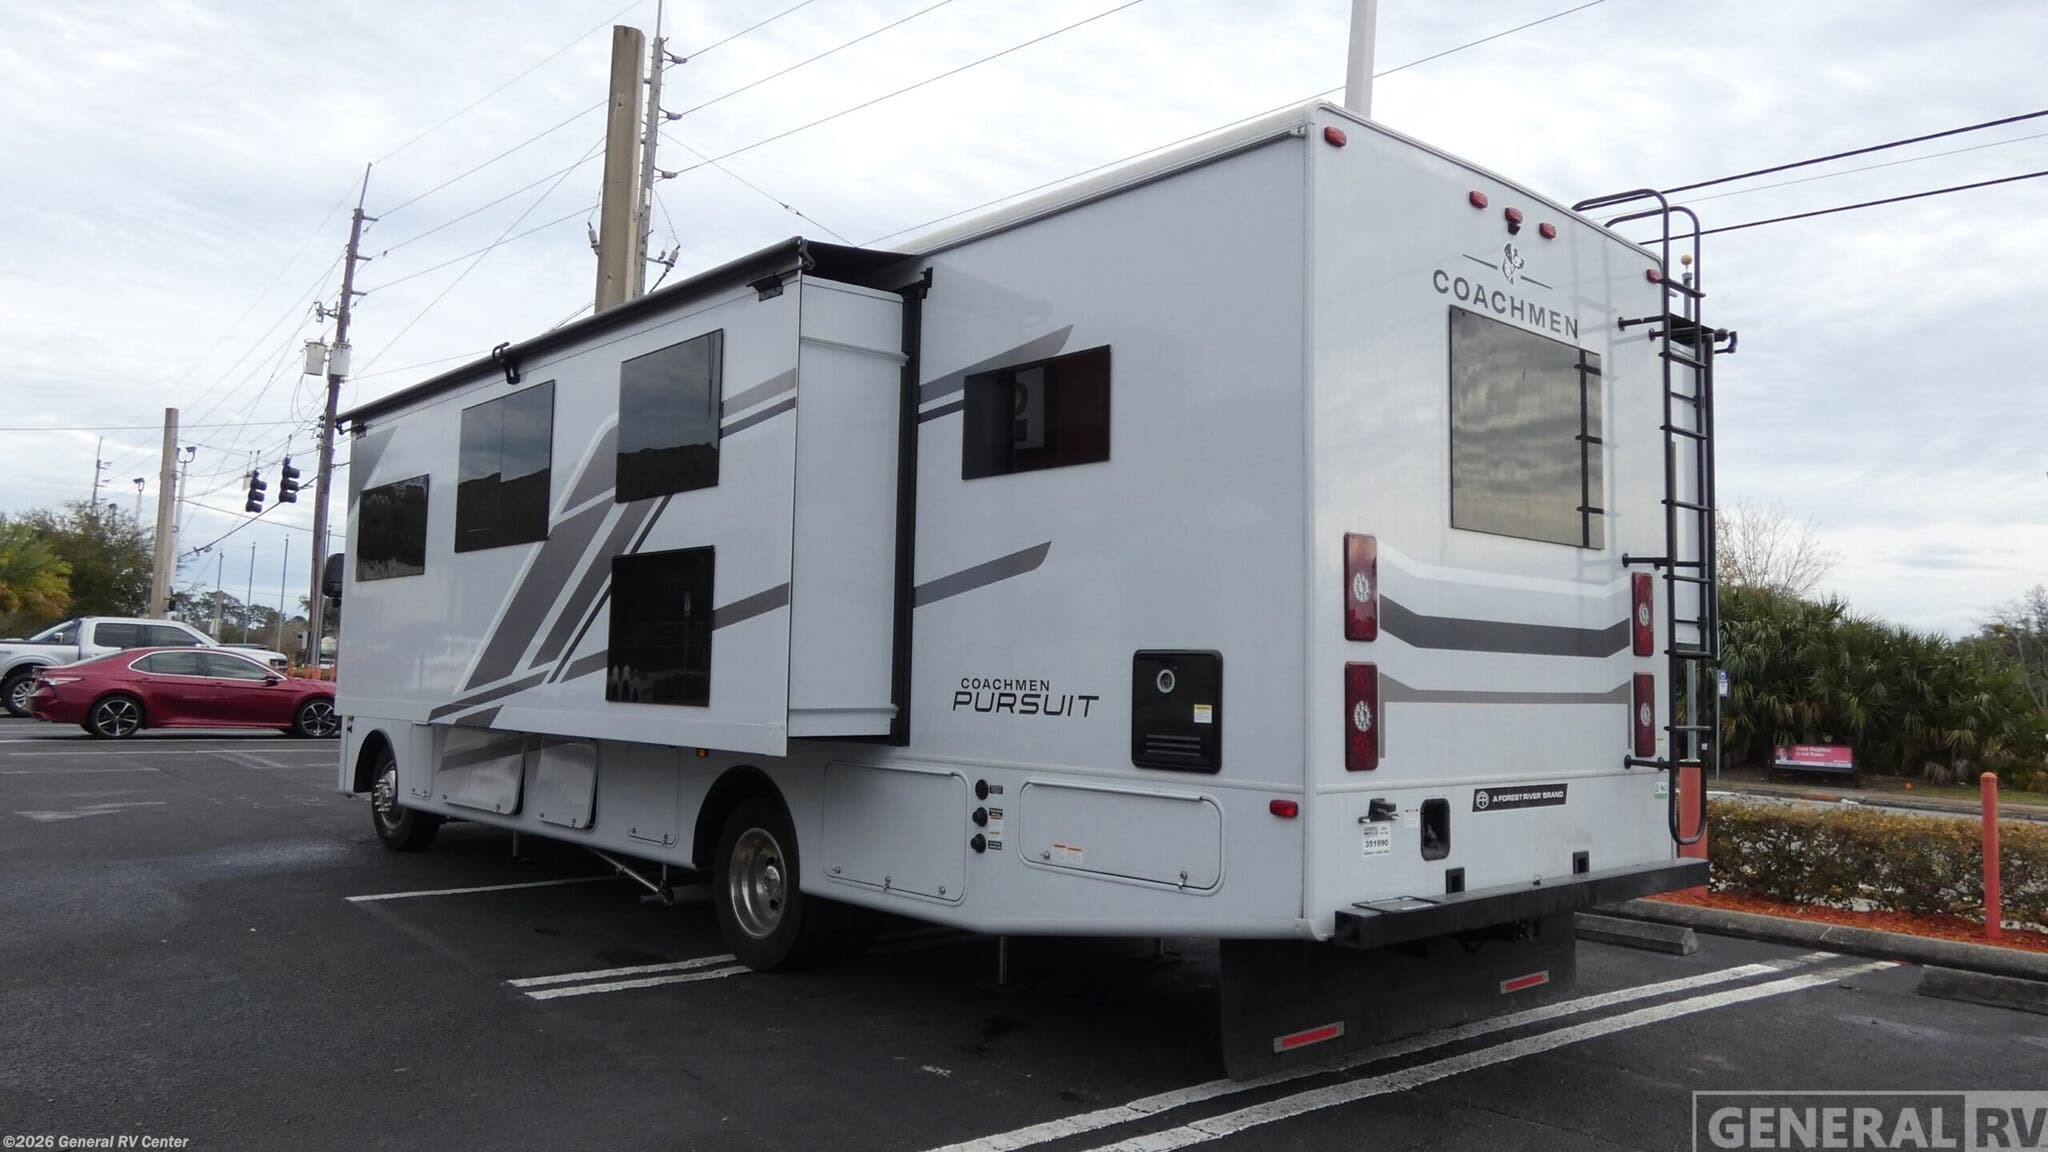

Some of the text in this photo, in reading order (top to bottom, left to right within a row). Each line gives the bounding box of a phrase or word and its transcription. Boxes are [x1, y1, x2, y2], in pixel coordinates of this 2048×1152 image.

[1433, 269, 1579, 339] COACHMEN
[961, 678, 1050, 692] COACHMEN
[953, 691, 1100, 717] PURSUIT
[1498, 794, 1522, 803] FOREST
[1523, 792, 1542, 801] RIVER
[1542, 790, 1564, 799] BRAND
